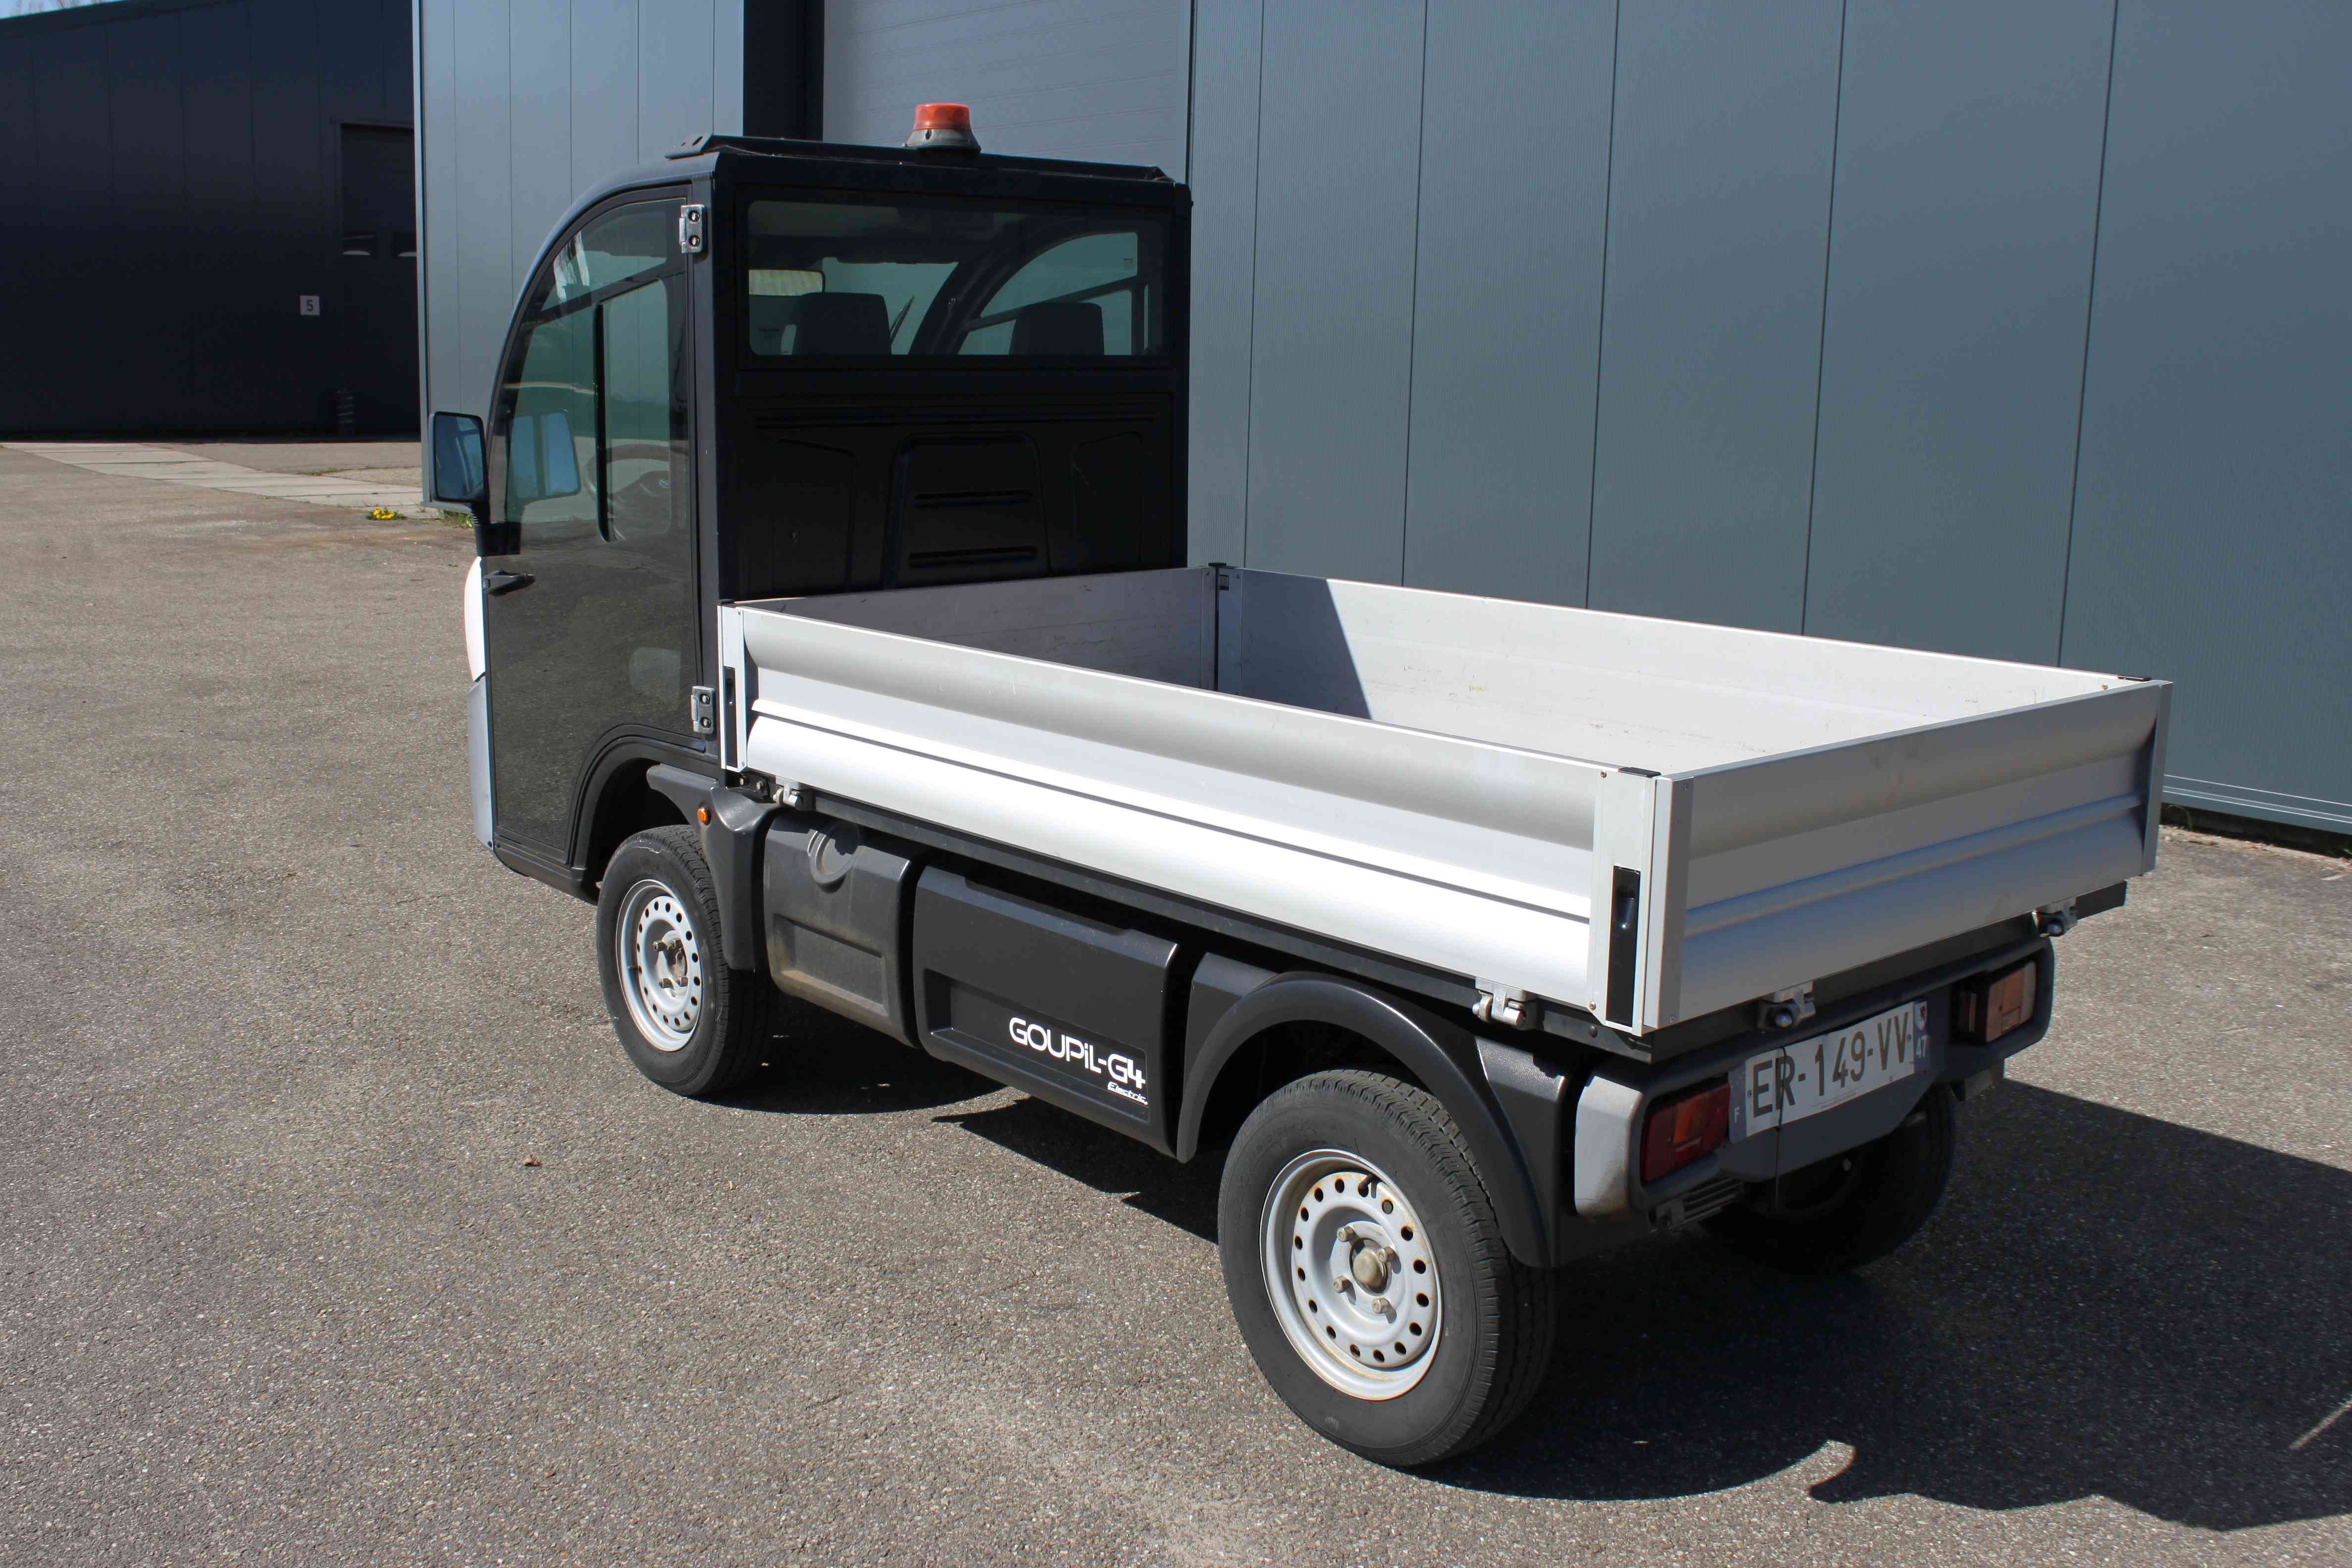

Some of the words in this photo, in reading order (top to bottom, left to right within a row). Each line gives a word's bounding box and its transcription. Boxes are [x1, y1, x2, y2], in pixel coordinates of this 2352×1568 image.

[306, 299, 313, 312] 5
[1915, 1034, 1928, 1059] 47
[1753, 1011, 1909, 1118] ER-149-VV
[1107, 1081, 1147, 1104] Electric
[1734, 1105, 1741, 1124] F
